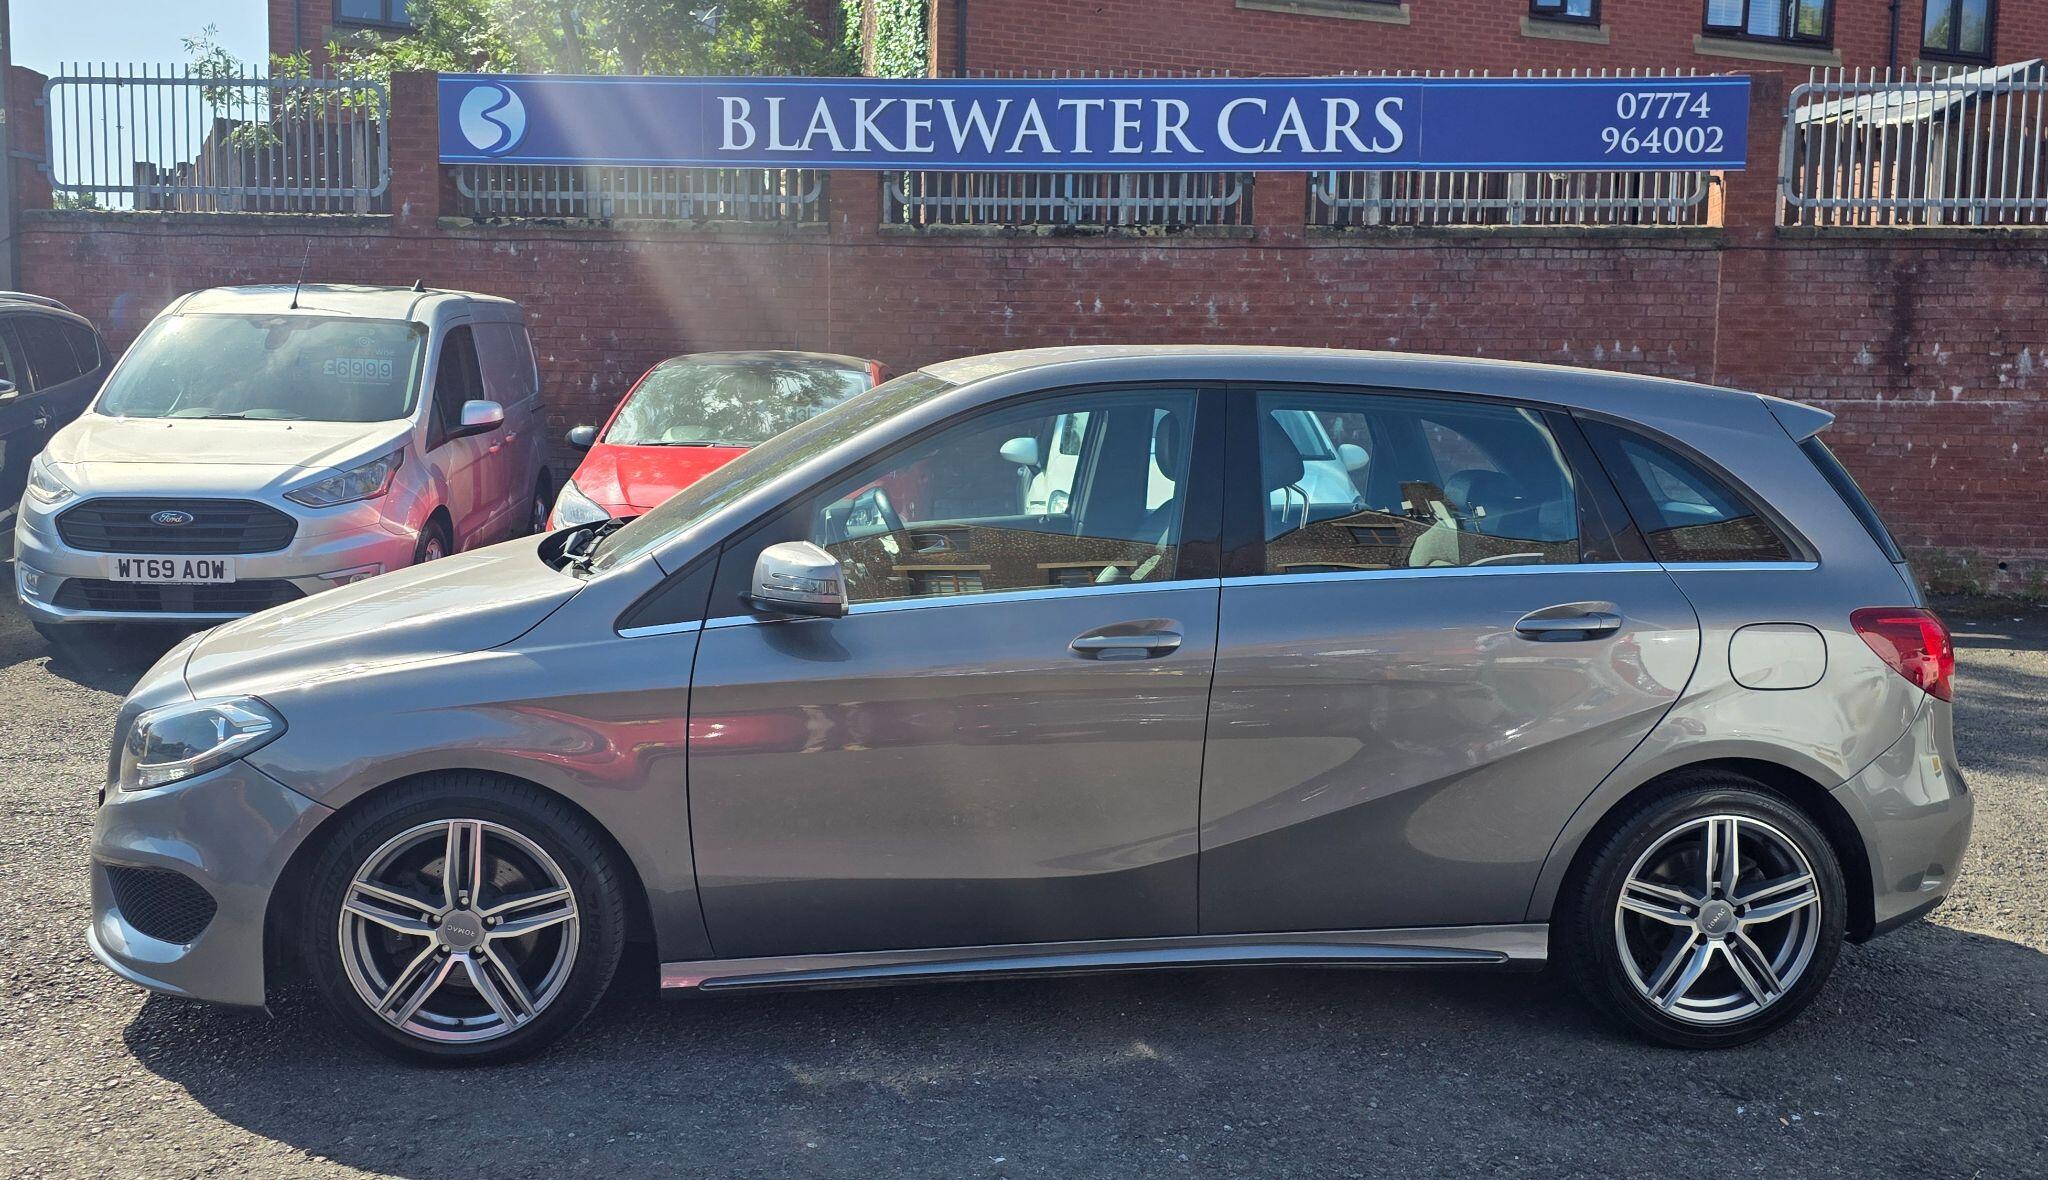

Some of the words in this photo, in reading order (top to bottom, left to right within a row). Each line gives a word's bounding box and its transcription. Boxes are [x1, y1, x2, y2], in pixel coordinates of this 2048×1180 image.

[1616, 91, 1711, 120] 07774
[717, 95, 1205, 154] BLAKEWATER
[1217, 96, 1404, 154] CARS
[1601, 126, 1724, 154] 964002
[323, 359, 393, 379] £6999
[158, 512, 183, 524] Ford
[117, 558, 175, 579] WT69
[182, 560, 225, 579] AOW
